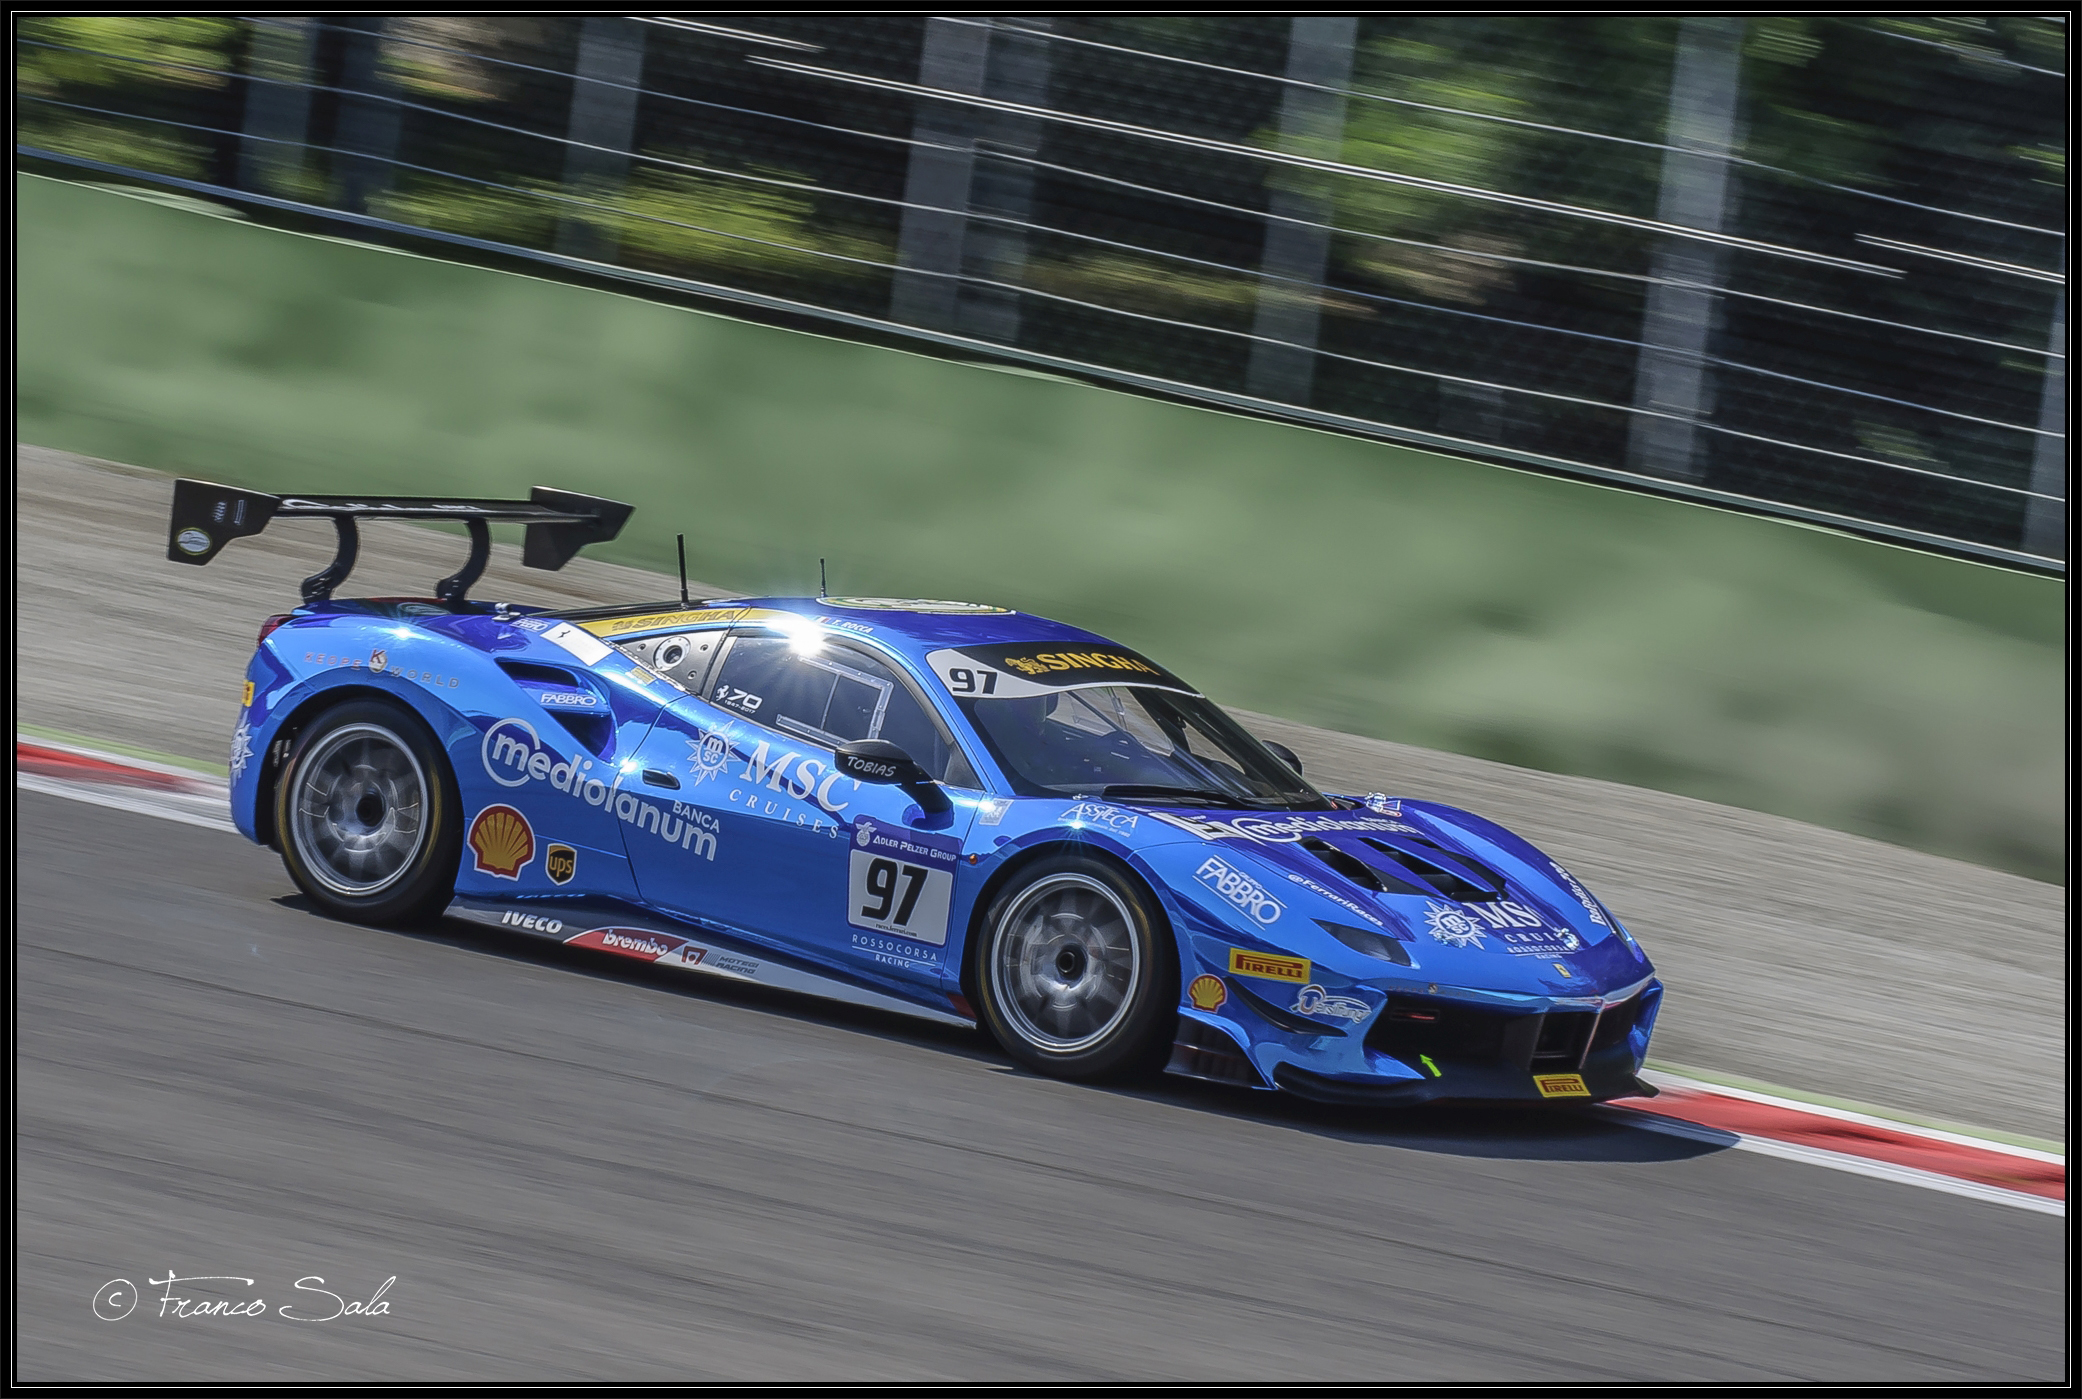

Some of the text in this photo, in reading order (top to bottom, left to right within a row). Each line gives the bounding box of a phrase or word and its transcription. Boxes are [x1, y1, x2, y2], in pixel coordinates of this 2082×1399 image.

[632, 610, 735, 628] SINGHA
[841, 621, 874, 633] ROCCA
[304, 651, 362, 670] KEOPE
[390, 665, 460, 689] WORLD
[1037, 653, 1160, 676] SINGHA
[949, 668, 998, 695] 97
[541, 693, 597, 706] FABBRO
[727, 688, 762, 709] 70
[739, 739, 862, 812] MSC
[847, 755, 896, 777] TOBIAS
[492, 733, 718, 861] mediolanum
[672, 799, 721, 833] BANCA
[729, 788, 839, 839] CRUISES
[1244, 815, 1425, 836] mediolanum
[872, 834, 957, 862] ADLER PELZER GROUP
[549, 855, 573, 878] ups
[860, 857, 929, 927] 97
[1195, 857, 1281, 924] FABBRO
[1287, 873, 1384, 927] @FerrariRaces
[501, 909, 563, 934] IVECO
[602, 928, 669, 956] brembo
[851, 934, 937, 961] ROSSOCORSA
[715, 962, 757, 975] RACING
[719, 956, 760, 969] MOTEGI
[875, 953, 910, 968] RACING
[1235, 953, 1304, 979] PIRELLI
[1540, 1078, 1585, 1092] PIRELLI
